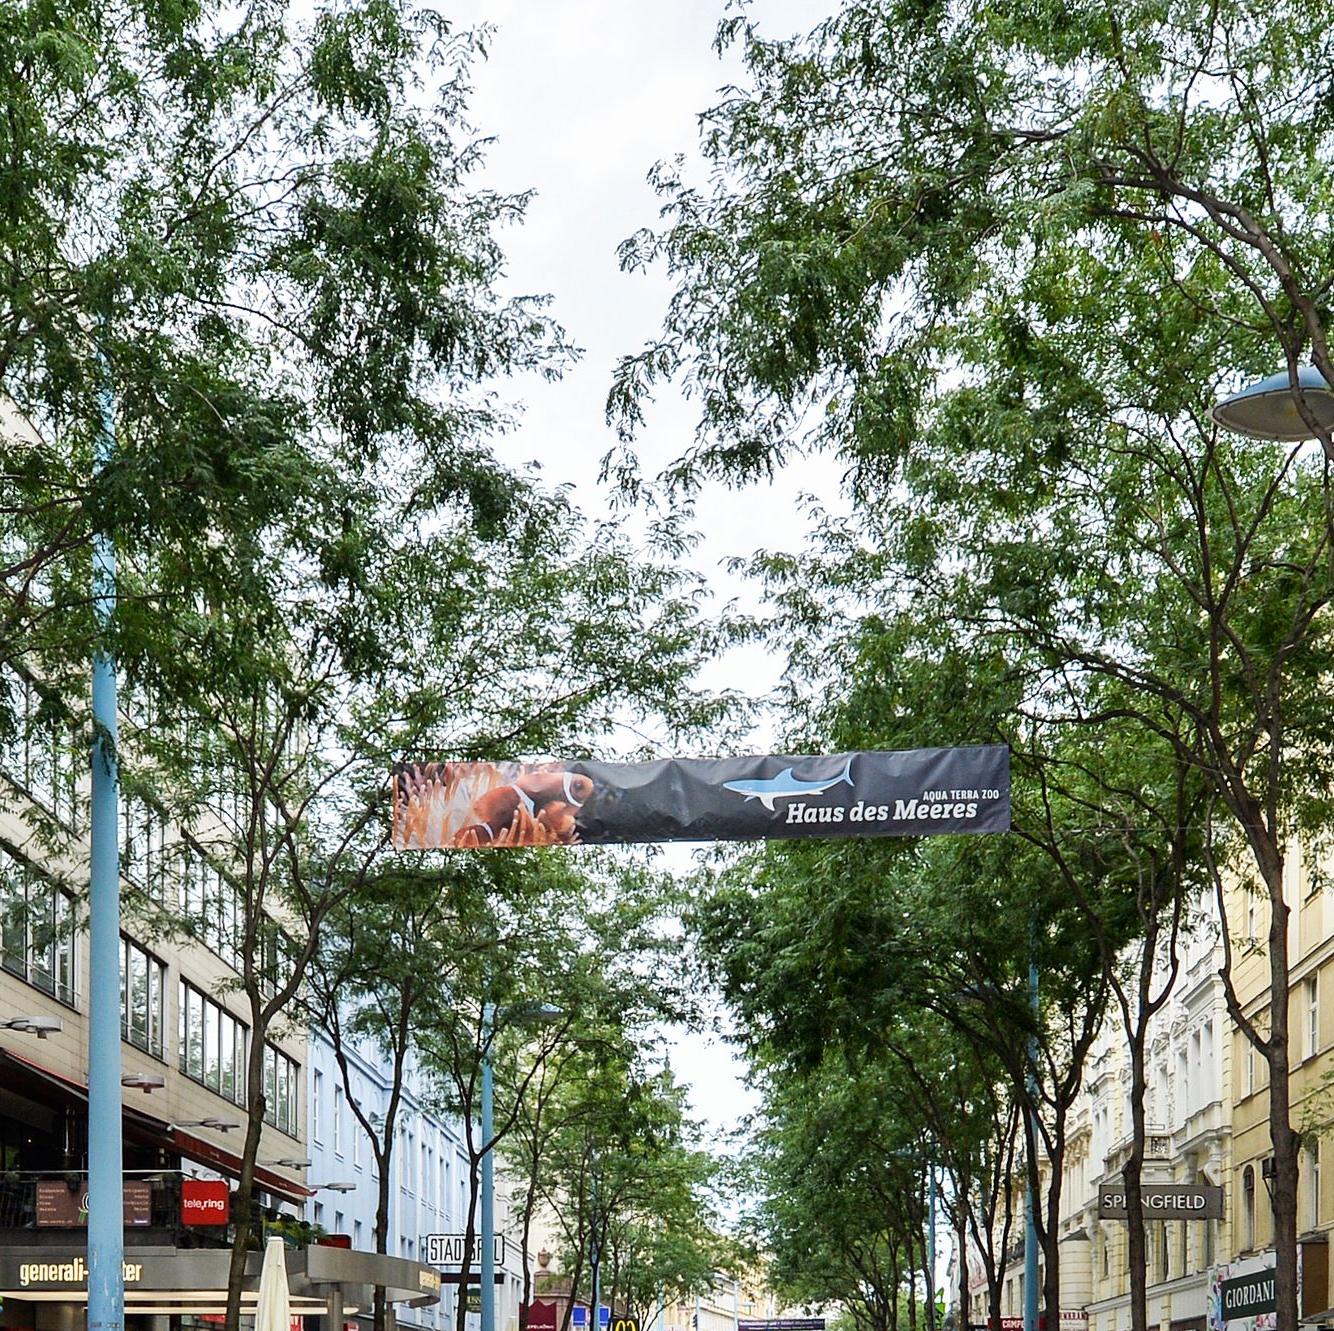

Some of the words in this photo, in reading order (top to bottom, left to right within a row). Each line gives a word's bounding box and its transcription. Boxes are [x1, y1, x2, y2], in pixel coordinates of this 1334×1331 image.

[922, 790, 948, 801] AQUA
[950, 790, 978, 800] TERRA
[981, 789, 1000, 799] ZOO
[786, 803, 844, 824] Haus
[849, 802, 888, 822] des
[892, 799, 978, 820] Meeres
[1104, 1194, 1206, 1210] SPNGFIELD
[1002, 1319, 1025, 1329] CAMPE
